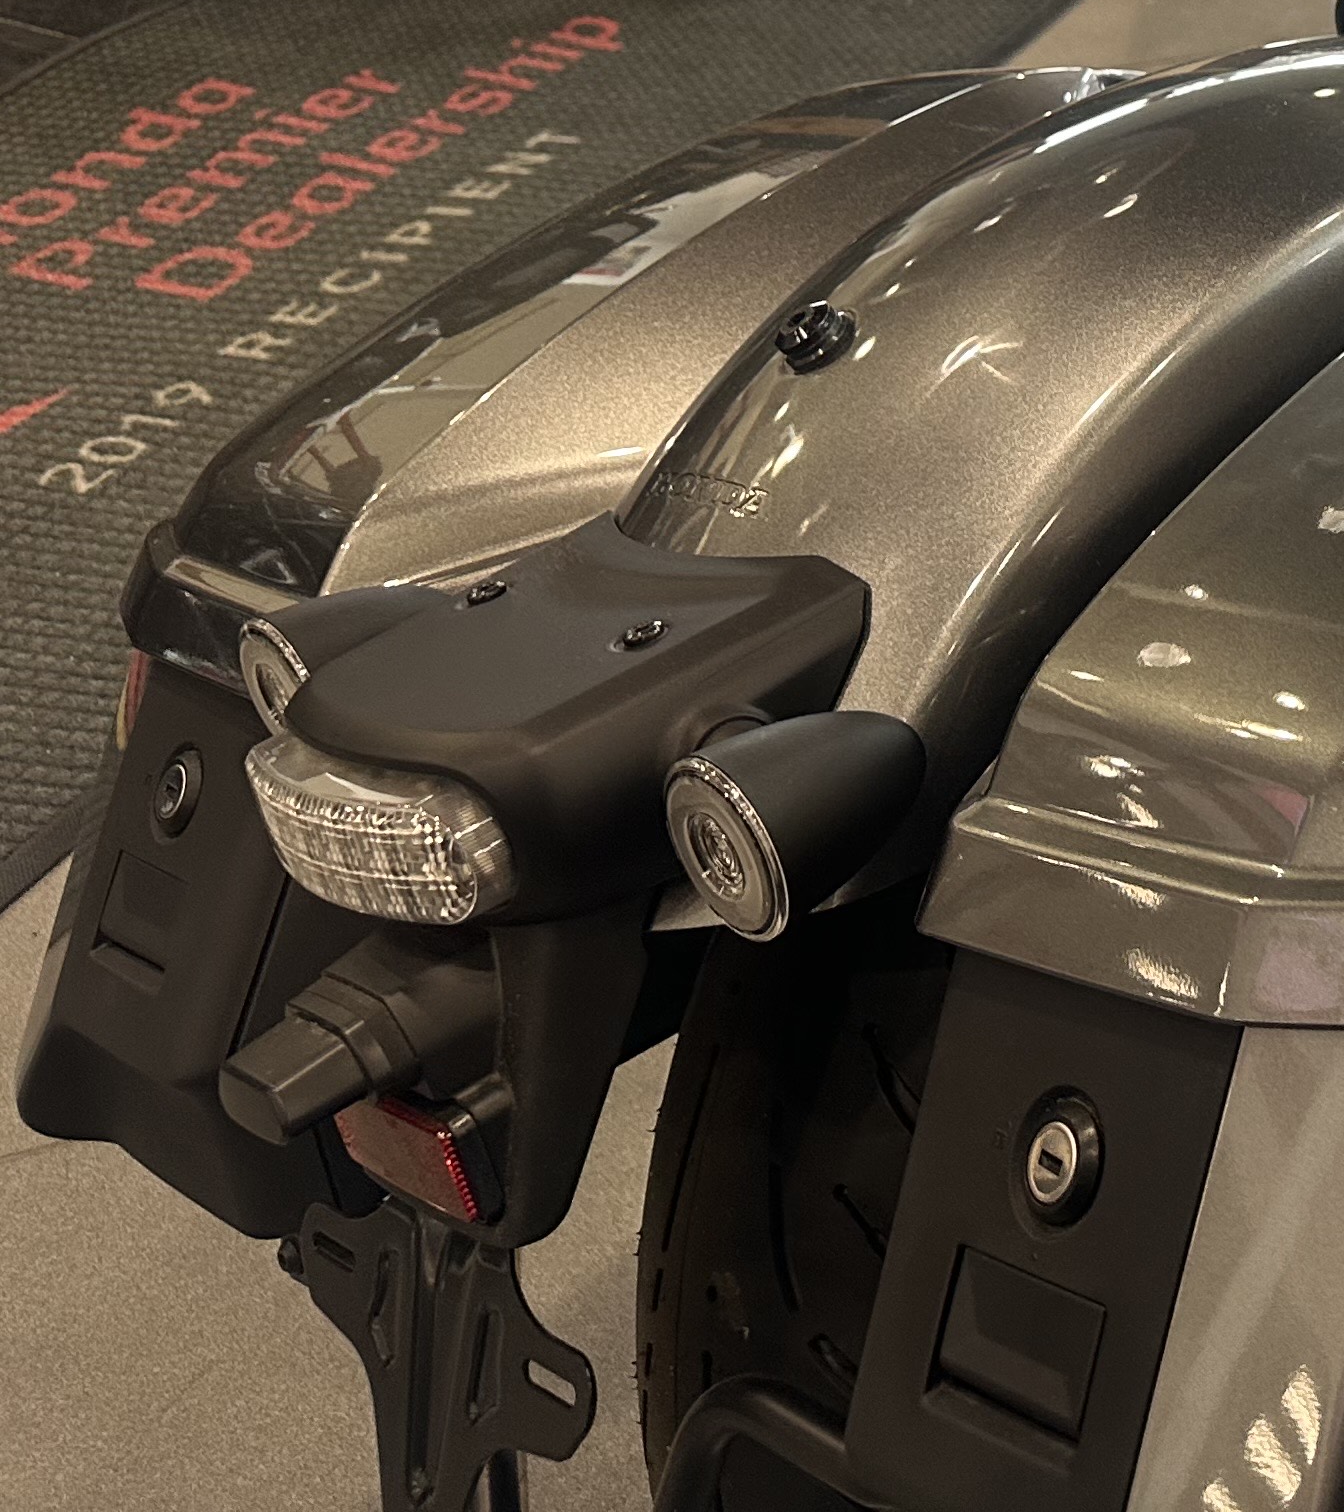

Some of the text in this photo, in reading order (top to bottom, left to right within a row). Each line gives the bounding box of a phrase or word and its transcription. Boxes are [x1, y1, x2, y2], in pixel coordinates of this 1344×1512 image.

[0, 77, 257, 246] onda
[8, 68, 402, 289] Premier
[134, 15, 625, 301] Dealership
[38, 129, 582, 494] 2019 RECIPIENT
